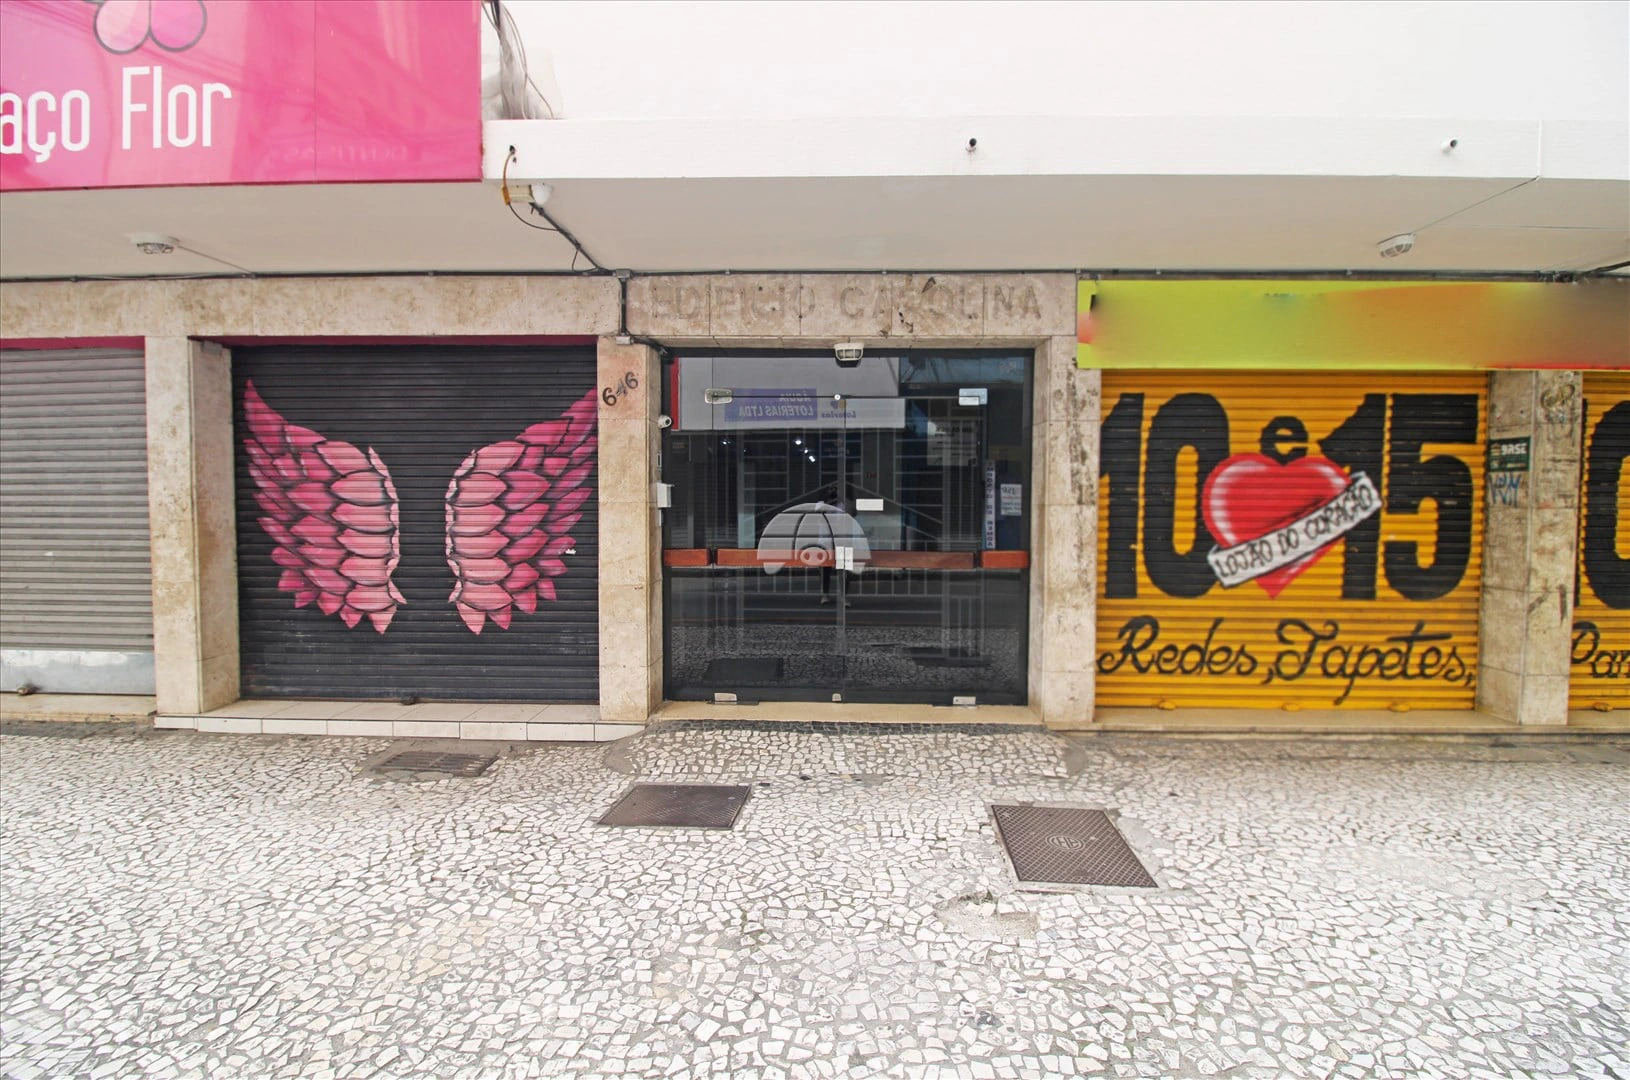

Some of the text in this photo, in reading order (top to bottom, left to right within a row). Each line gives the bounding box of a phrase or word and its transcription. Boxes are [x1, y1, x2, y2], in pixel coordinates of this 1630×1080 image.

[0, 66, 232, 163] aço Flor
[839, 285, 1042, 320] CAOLINA
[602, 371, 639, 407] 646
[1099, 391, 1482, 601] 10 e 15
[1214, 484, 1374, 579] LOJÃO DO CORAÇÃO
[1098, 615, 1275, 685] Redes,
